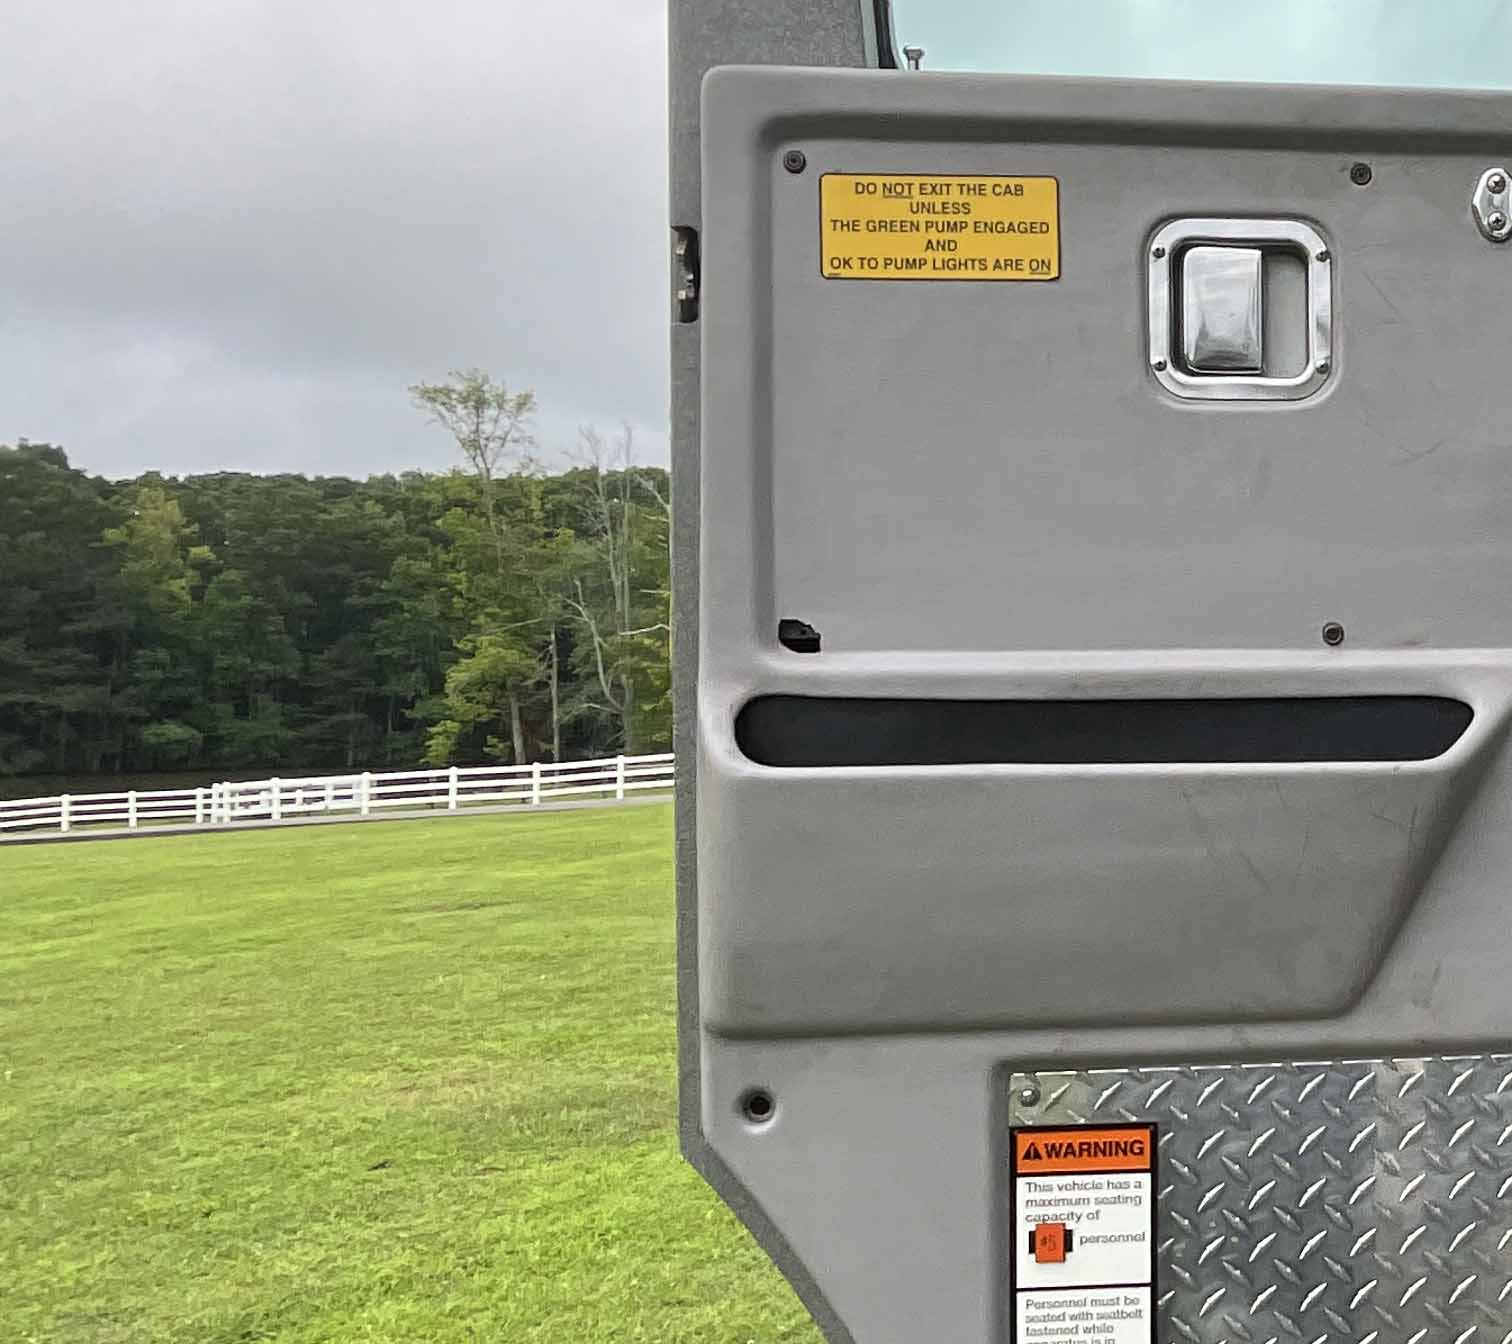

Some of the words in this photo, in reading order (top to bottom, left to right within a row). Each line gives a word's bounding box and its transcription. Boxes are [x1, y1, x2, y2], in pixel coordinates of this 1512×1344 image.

[855, 182, 877, 195] DO
[882, 183, 914, 196] NOT
[919, 184, 952, 196] EXIT
[957, 184, 986, 196] THE
[992, 184, 1024, 196] CAB
[910, 202, 971, 214] UNLESS
[831, 219, 861, 232] THE
[866, 220, 920, 233] GREEN
[925, 221, 968, 233] PUMP
[974, 221, 1050, 234] ENGAGED
[924, 240, 958, 252] AND
[830, 257, 852, 270] OK
[859, 257, 878, 270] TO
[884, 258, 927, 270] PUMP
[932, 259, 988, 271] LIGHTS
[993, 259, 1023, 271] ARE
[1029, 259, 1051, 272] ON
[1044, 1139, 1144, 1159] WARNING
[1025, 1182, 1053, 1192] This
[1057, 1181, 1103, 1191] vehicle
[1107, 1180, 1130, 1189] has
[1134, 1181, 1142, 1189] a
[1026, 1196, 1090, 1207] maximum
[1095, 1195, 1142, 1206] seating
[1025, 1211, 1082, 1224] capacity
[1087, 1209, 1100, 1220] of
[1080, 1232, 1145, 1245] personnel
[1026, 1297, 1087, 1309] Personnel
[1091, 1296, 1120, 1307] must
[1124, 1296, 1140, 1306] be
[1025, 1312, 1066, 1323] seated
[1069, 1311, 1093, 1321] with
[1096, 1309, 1142, 1320] seatbelt
[1026, 1324, 1079, 1336] fastened
[1083, 1323, 1114, 1334] while
